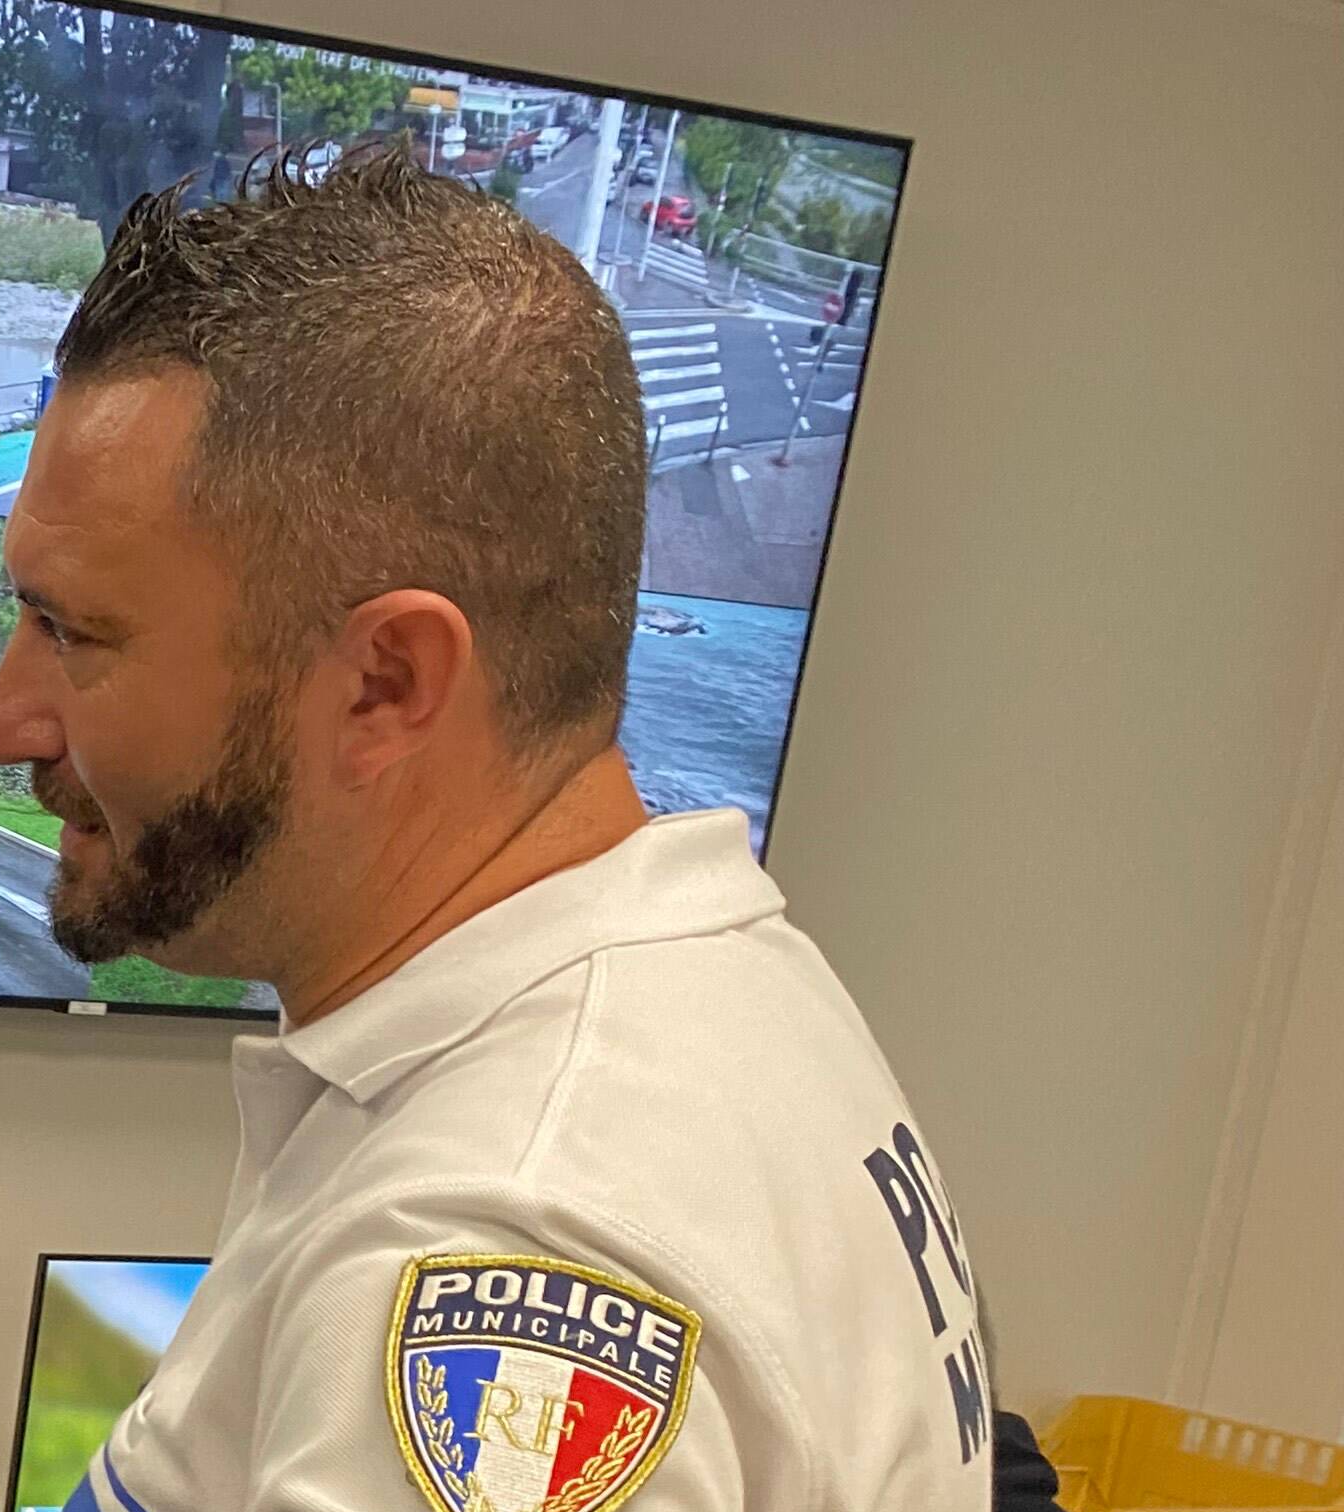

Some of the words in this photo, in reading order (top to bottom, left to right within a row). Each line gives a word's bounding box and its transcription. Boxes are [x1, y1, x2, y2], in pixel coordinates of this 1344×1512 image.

[413, 1309, 674, 1389] MUNICIPALE
[416, 1268, 682, 1362] POLICE
[463, 1378, 585, 1458] RF
